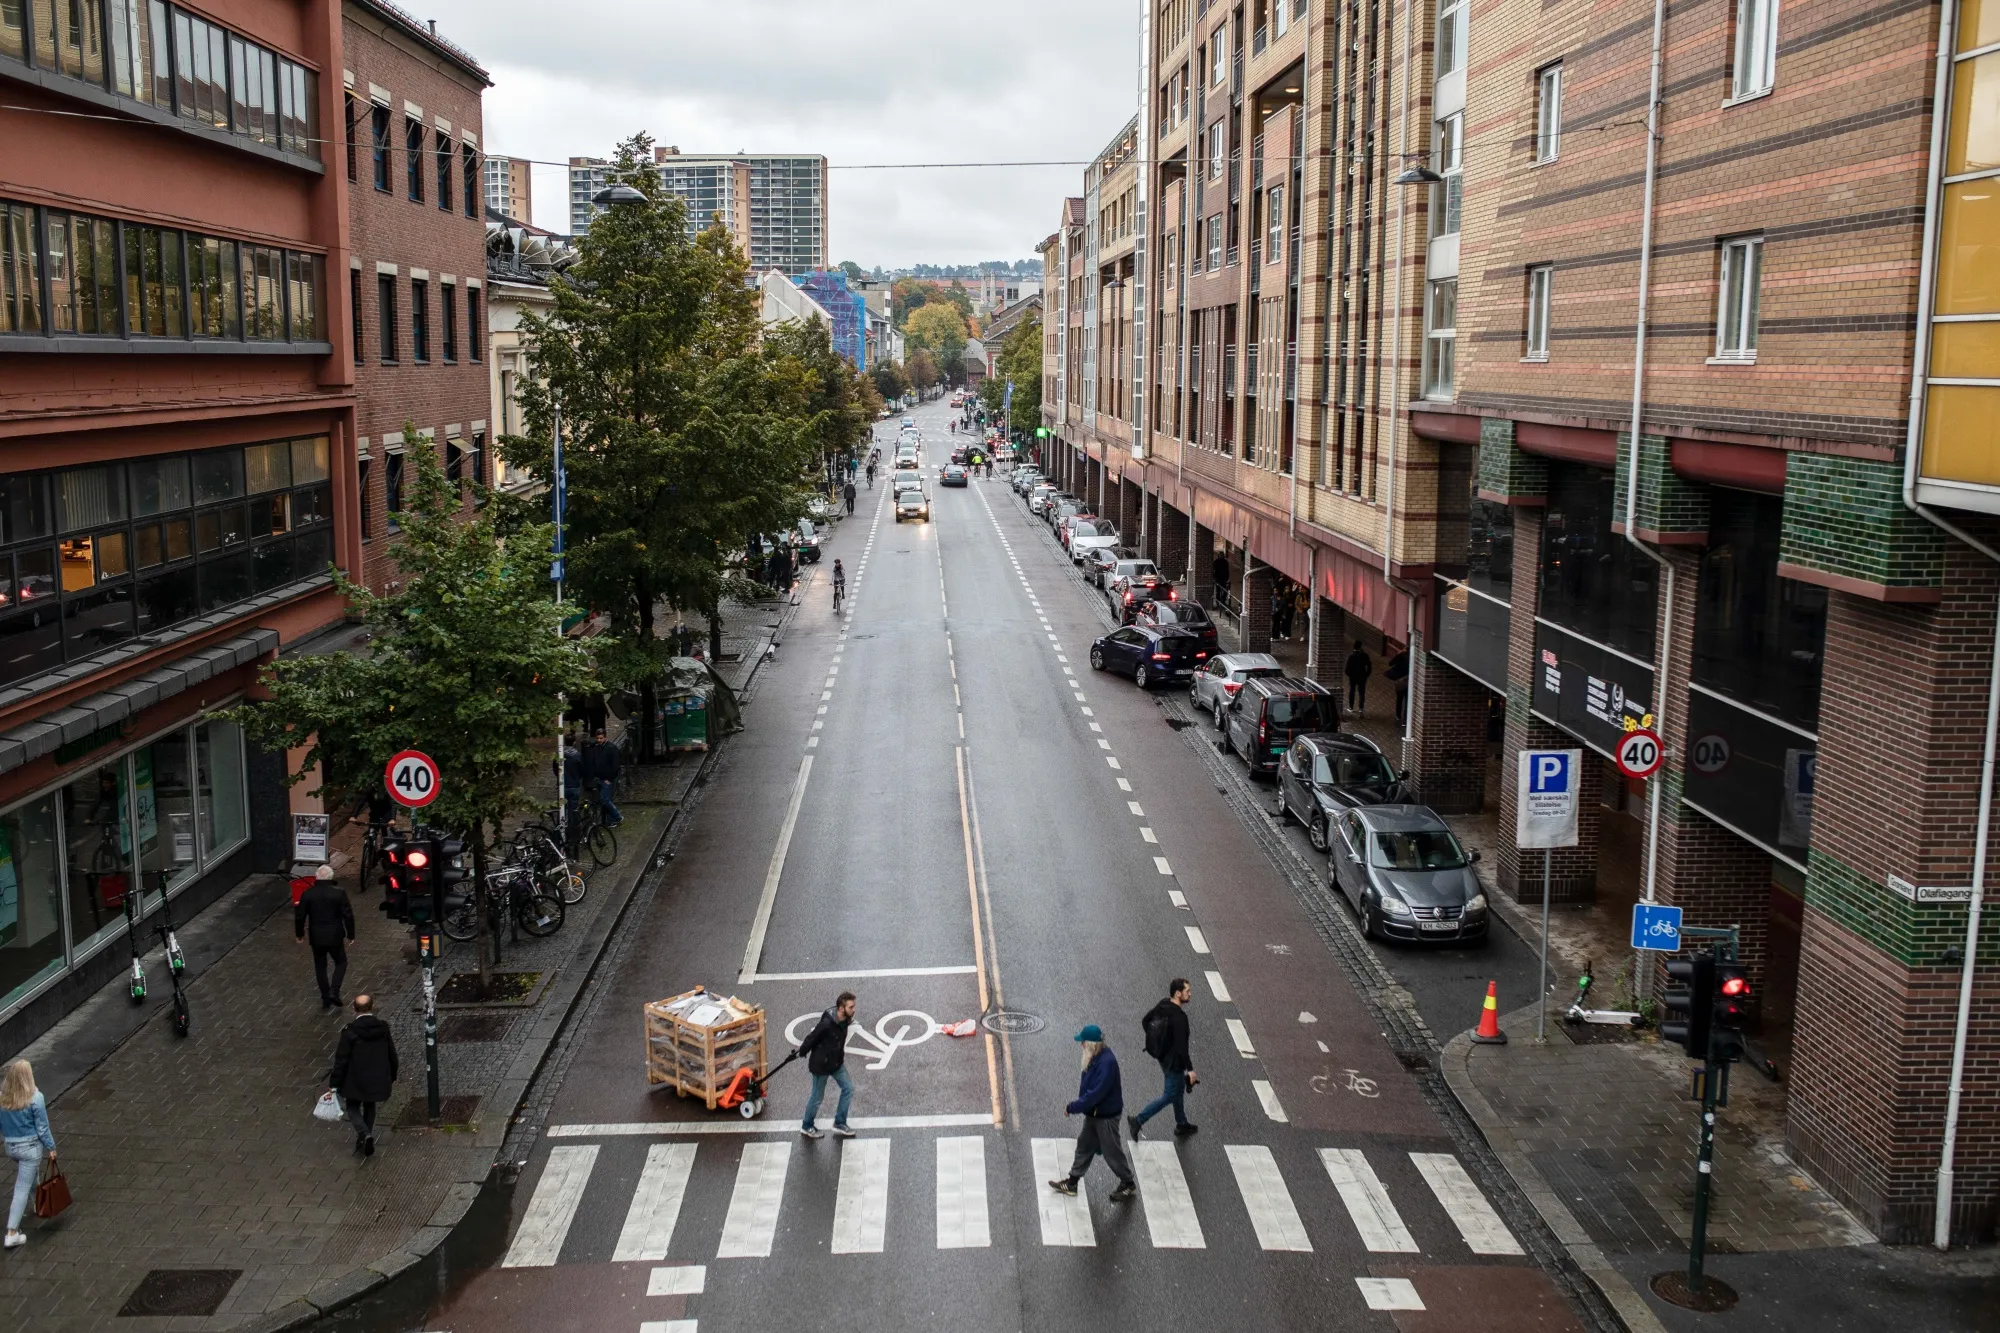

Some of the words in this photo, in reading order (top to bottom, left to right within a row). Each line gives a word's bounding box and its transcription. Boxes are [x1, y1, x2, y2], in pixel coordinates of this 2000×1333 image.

[1624, 742, 1656, 765] 40
[396, 765, 431, 792] 40
[1537, 756, 1562, 790] P
[1920, 888, 1973, 899] Olafiagang
